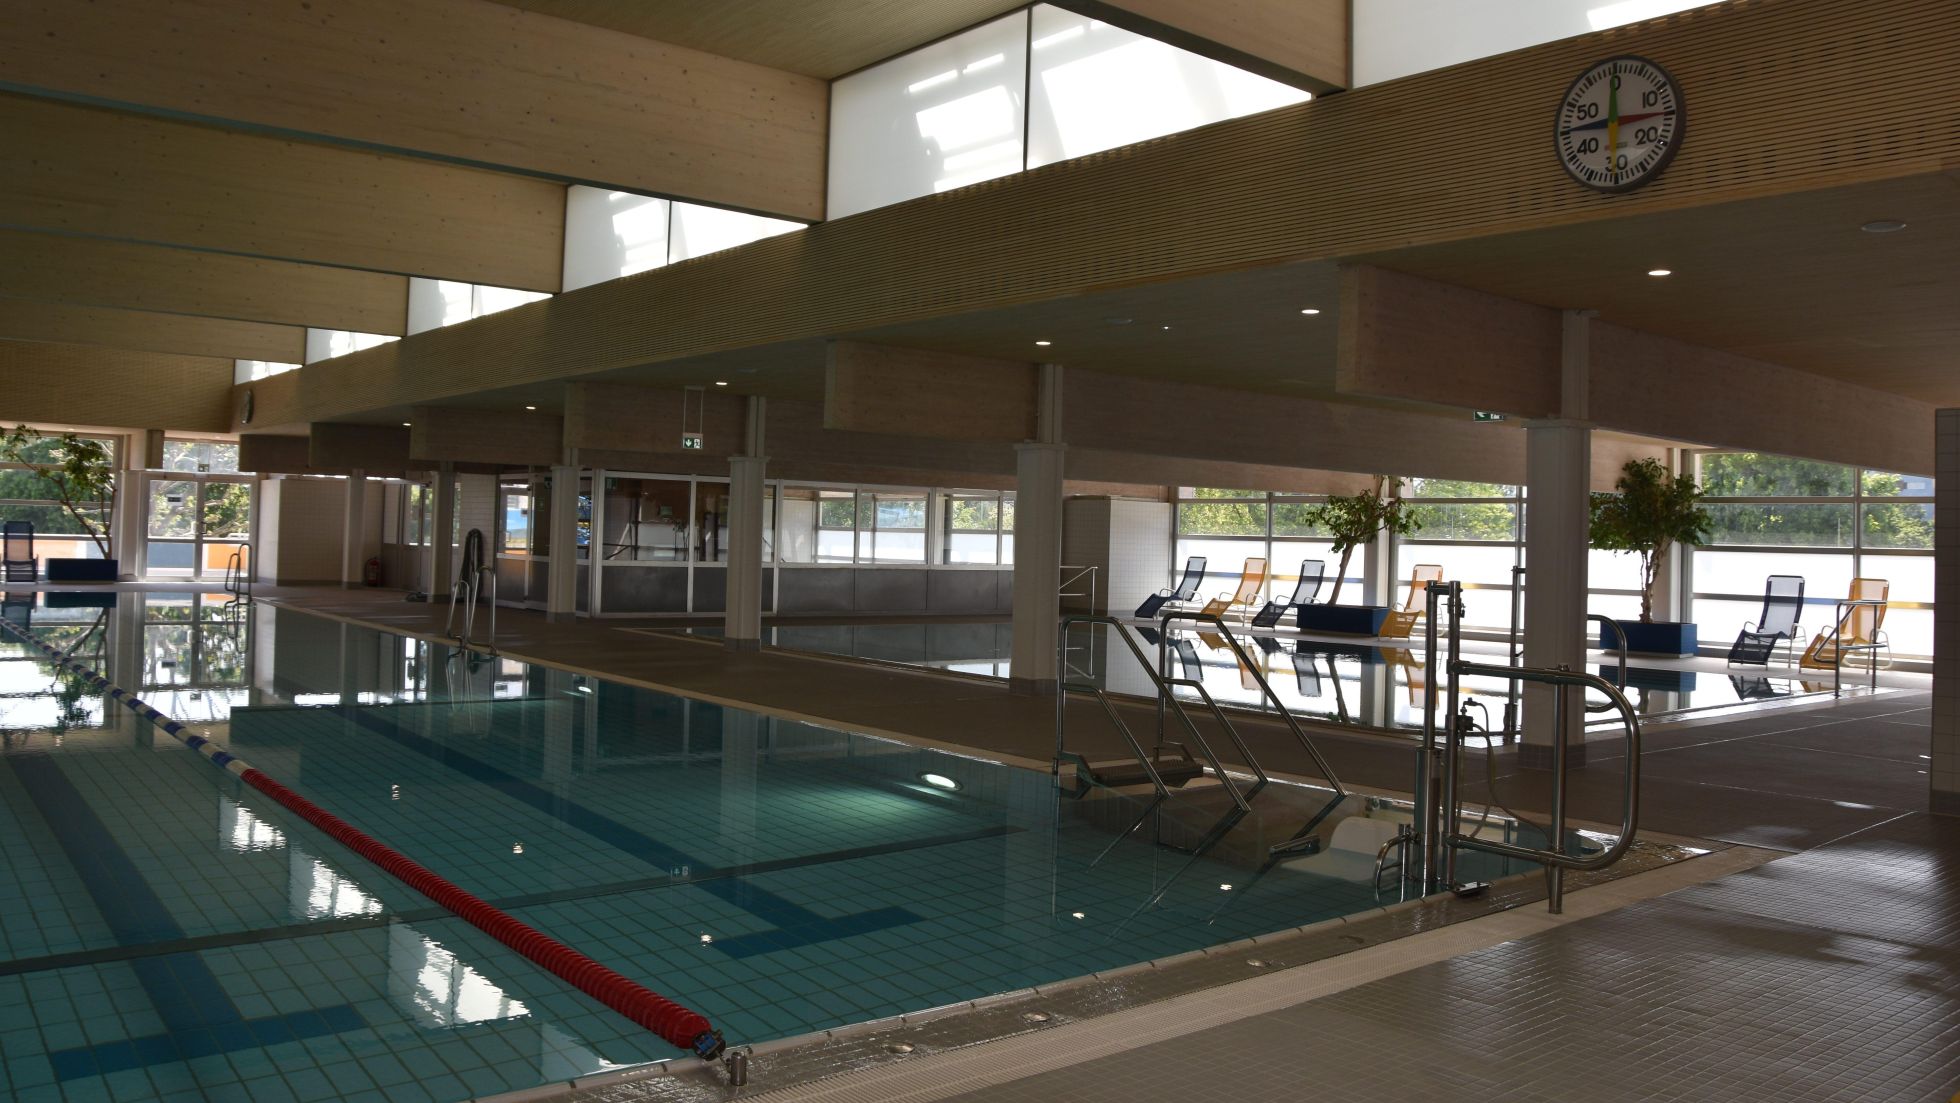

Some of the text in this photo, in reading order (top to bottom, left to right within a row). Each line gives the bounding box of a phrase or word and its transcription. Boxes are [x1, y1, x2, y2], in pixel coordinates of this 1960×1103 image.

[1642, 90, 1658, 109] 10
[1577, 102, 1599, 121] 50
[1635, 126, 1658, 146] 20
[1577, 137, 1599, 155] 40
